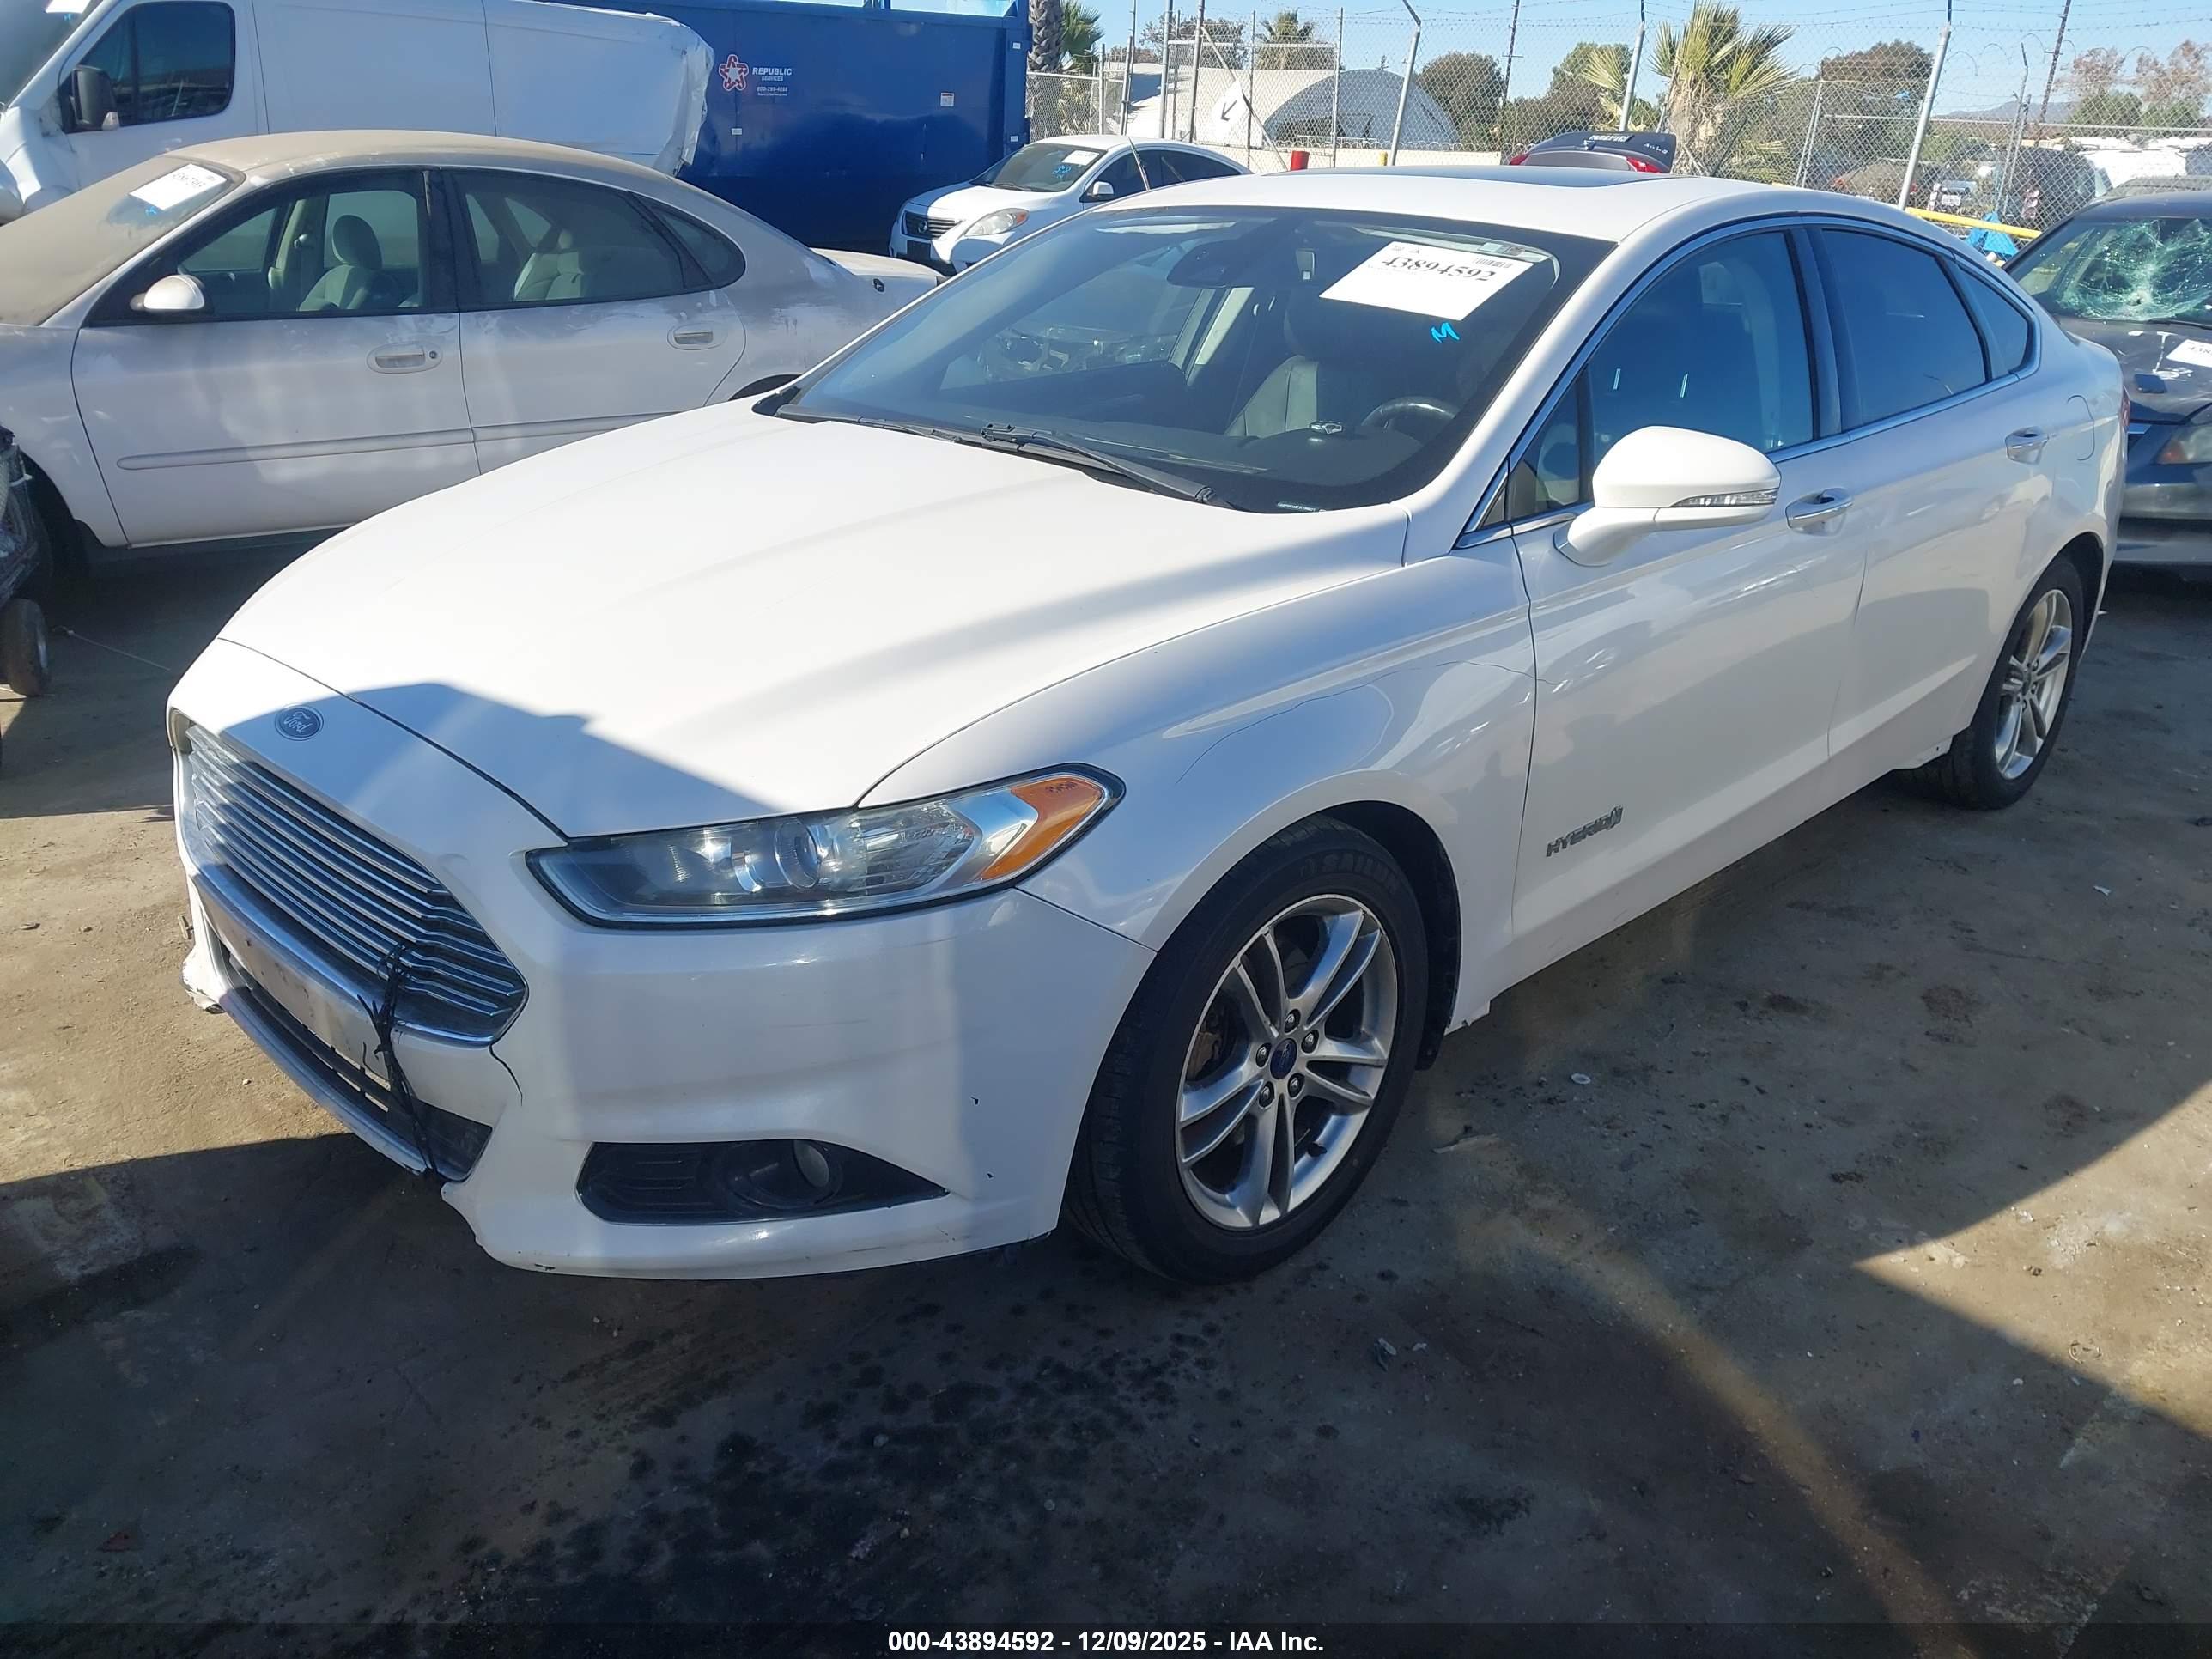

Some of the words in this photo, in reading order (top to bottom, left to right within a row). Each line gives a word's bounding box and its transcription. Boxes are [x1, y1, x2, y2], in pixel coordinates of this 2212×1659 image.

[752, 67, 793, 76] REPUBLIC
[1381, 256, 1497, 282] 43894592
[283, 712, 313, 733] Ford
[1546, 813, 1612, 857] HYBRID
